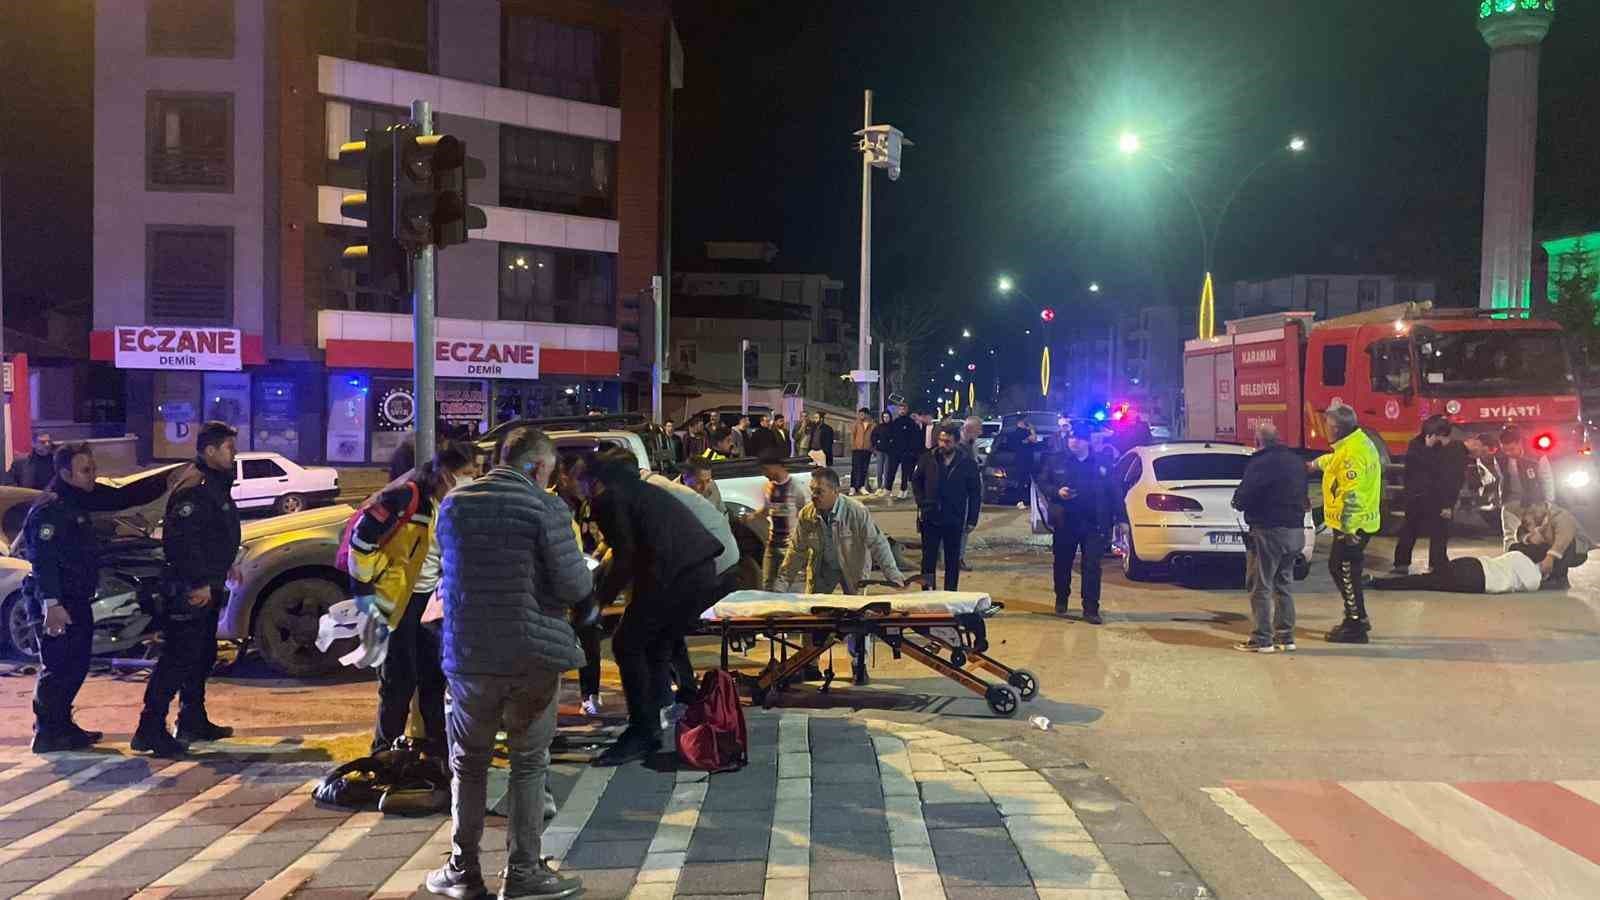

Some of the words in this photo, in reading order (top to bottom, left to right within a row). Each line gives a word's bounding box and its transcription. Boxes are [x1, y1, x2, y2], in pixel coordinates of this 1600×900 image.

[118, 328, 236, 354] ECZANE
[159, 355, 197, 366] DEMİR
[435, 341, 534, 364] ECZANE
[1241, 349, 1277, 364] KARAMAN
[467, 364, 502, 375] DEMİR
[1240, 380, 1280, 397] BELEDİYESİ
